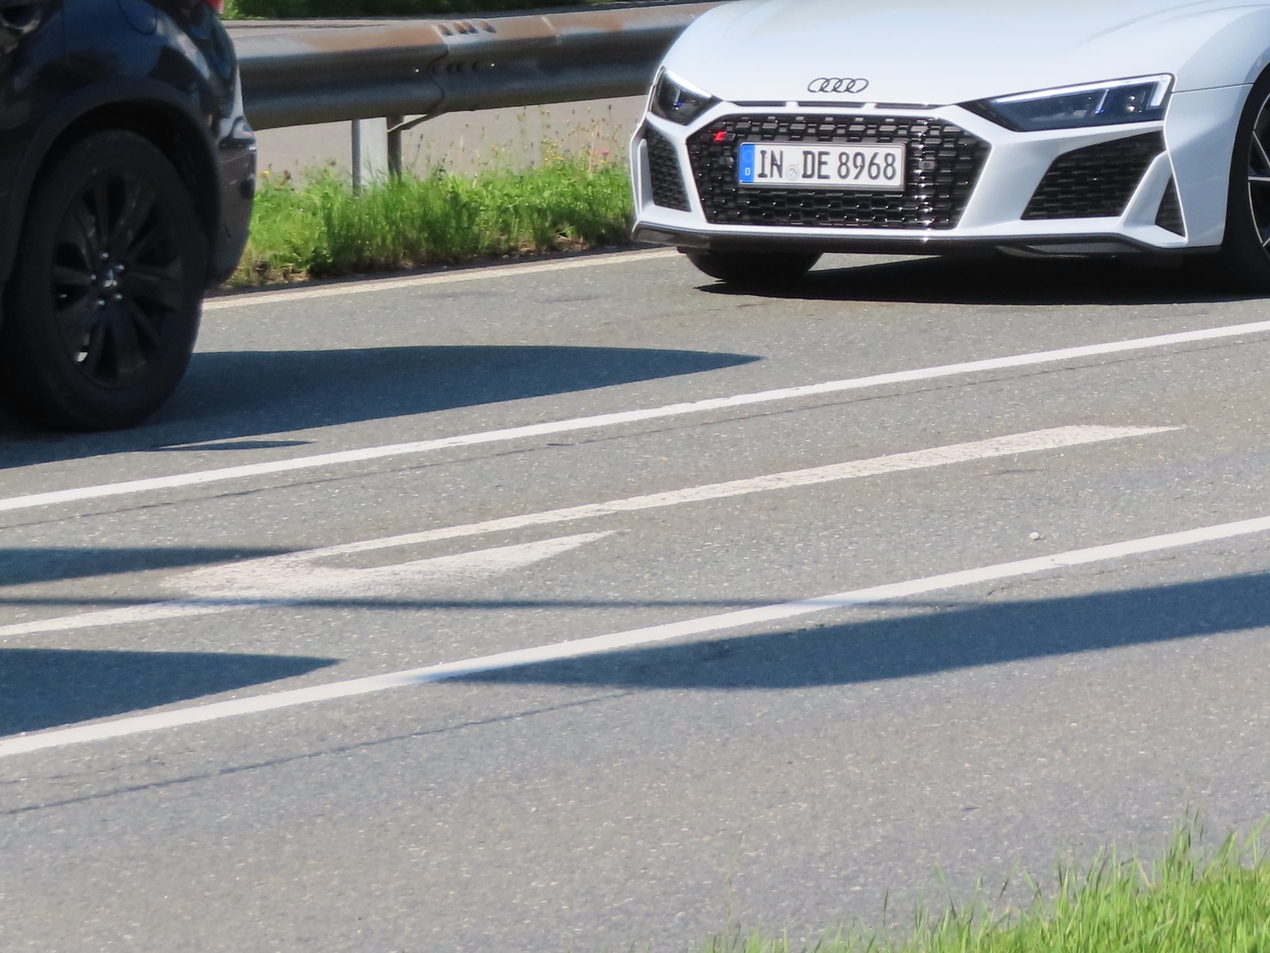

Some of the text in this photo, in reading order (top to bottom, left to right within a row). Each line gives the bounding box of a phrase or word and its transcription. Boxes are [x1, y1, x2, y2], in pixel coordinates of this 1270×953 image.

[744, 167, 751, 177] D
[757, 150, 897, 180] IN DE 8968
